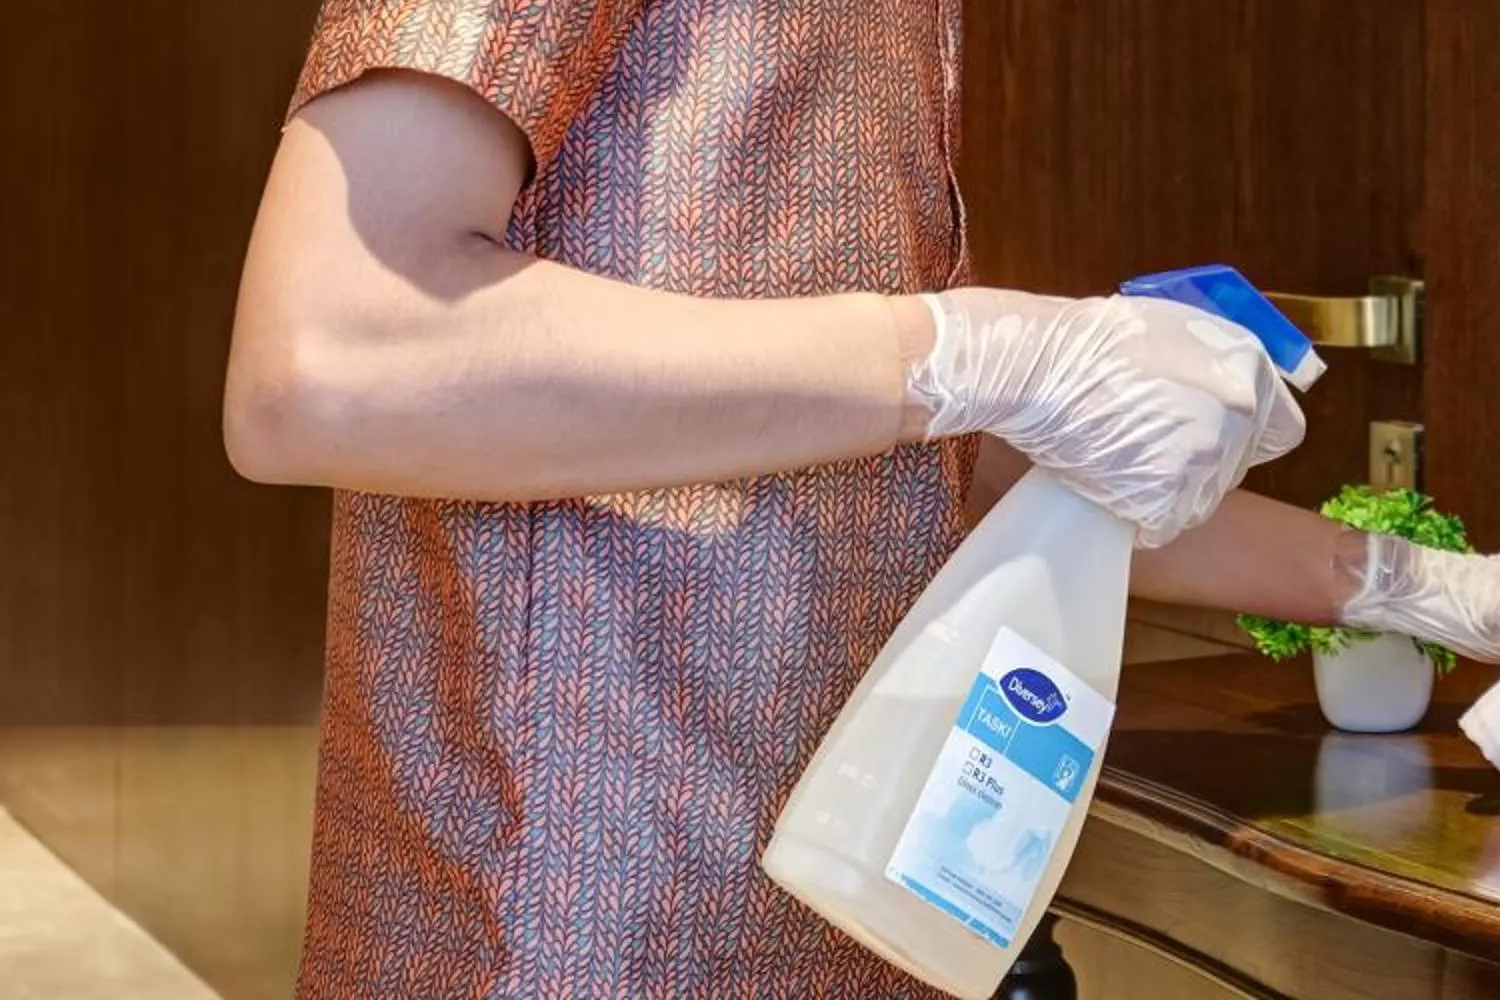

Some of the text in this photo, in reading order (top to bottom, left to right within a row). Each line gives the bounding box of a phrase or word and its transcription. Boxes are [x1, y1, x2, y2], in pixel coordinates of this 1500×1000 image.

[1007, 676, 1047, 715] Diversey
[977, 706, 1012, 739] TASKI
[979, 752, 993, 769] R3
[972, 767, 1004, 796] R3 Plus
